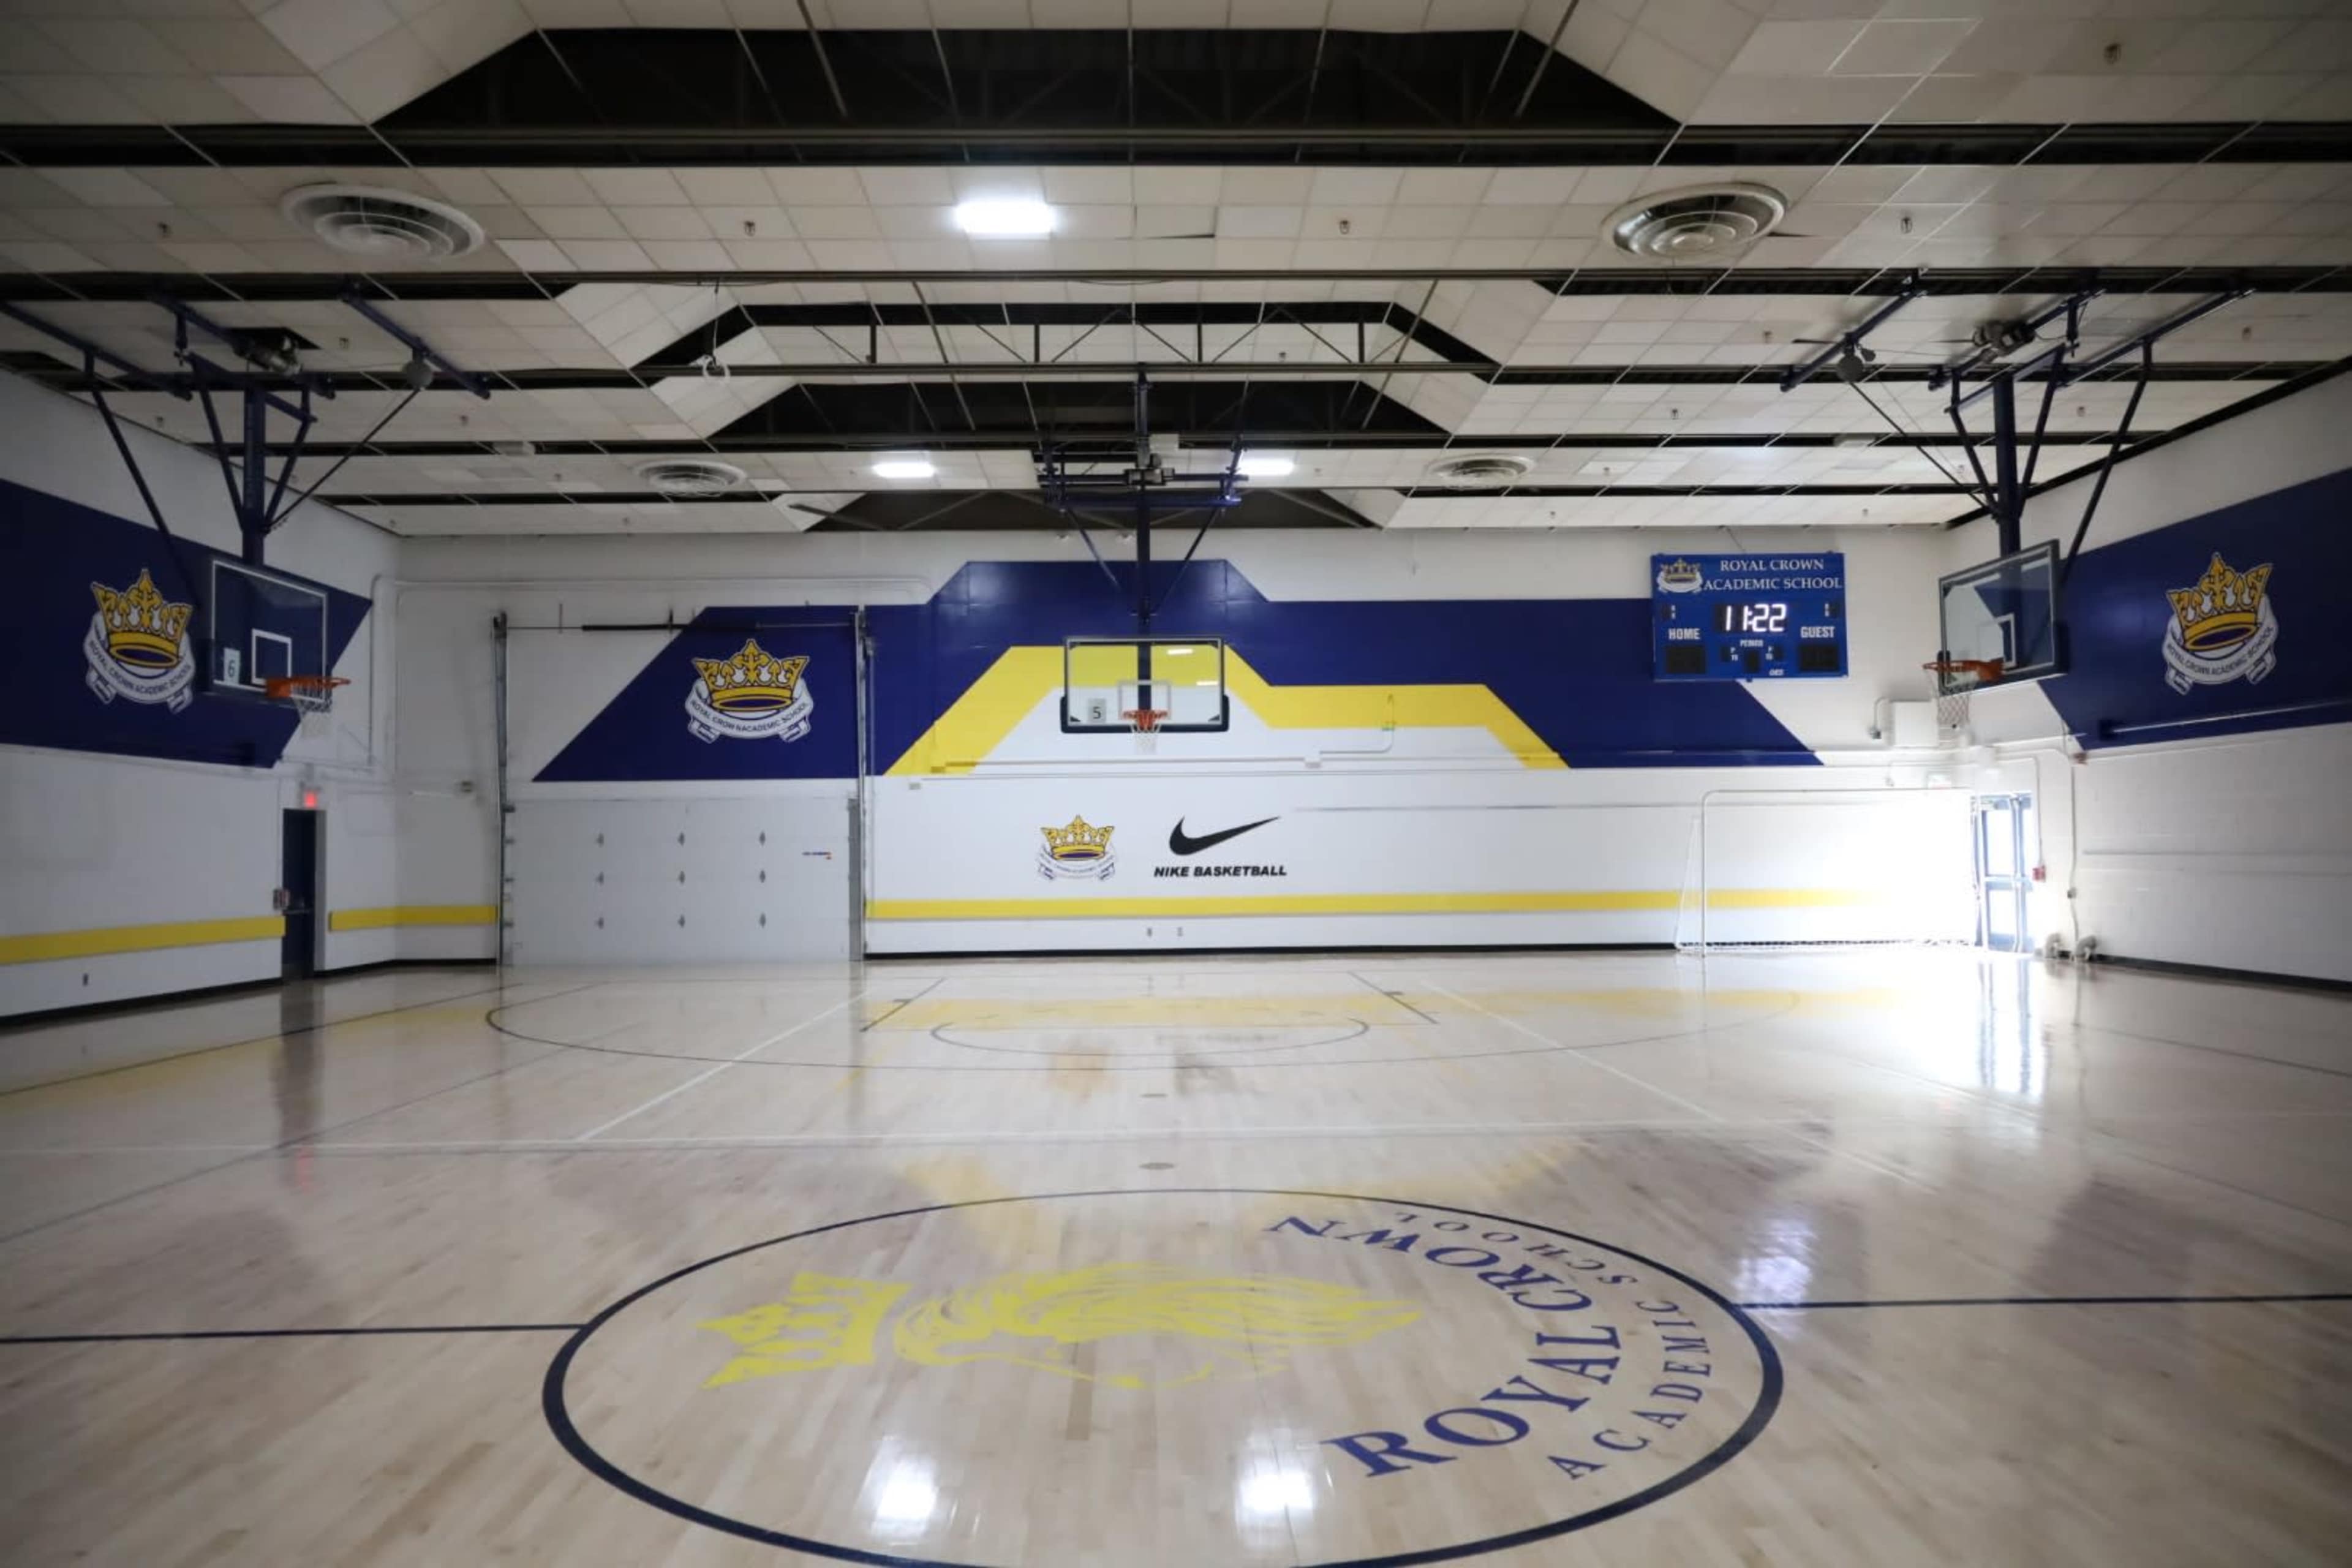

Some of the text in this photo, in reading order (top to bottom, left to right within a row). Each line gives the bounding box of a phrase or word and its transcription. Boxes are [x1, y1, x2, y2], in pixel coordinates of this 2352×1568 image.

[1721, 559, 1824, 571] ROYAL CROWN
[1703, 578, 1843, 591] ACADEMIC SCHOOL
[1725, 603, 1787, 632] 11:22
[1668, 628, 1700, 639] HOME
[1801, 627, 1835, 638] GUEST
[227, 660, 235, 677] 6
[1092, 706, 1101, 719] 5
[1154, 865, 1287, 877] NIKE BASKETBALL
[1265, 1216, 1621, 1477] ROYAL CROWN
[1395, 1212, 1711, 1480] ACADEMIC SCHOOL
